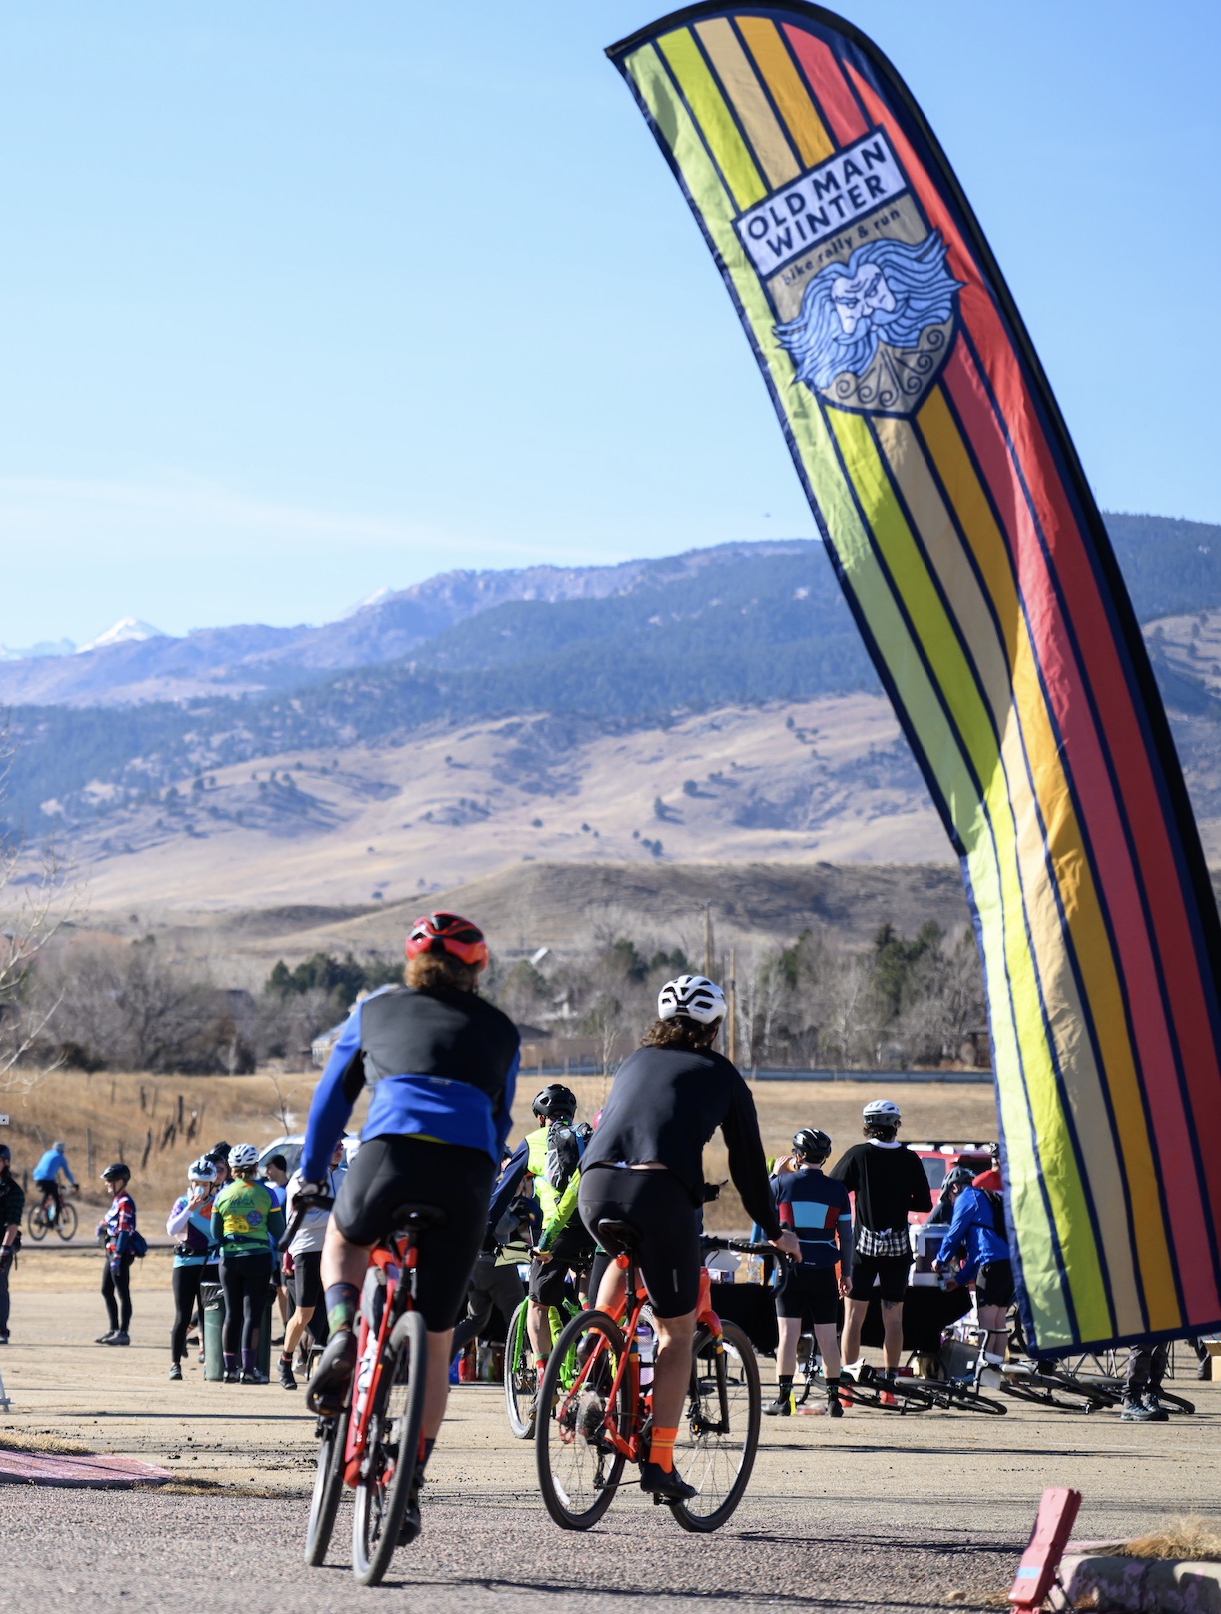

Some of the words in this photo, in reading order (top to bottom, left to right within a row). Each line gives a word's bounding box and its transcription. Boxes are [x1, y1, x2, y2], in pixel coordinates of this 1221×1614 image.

[748, 192, 806, 240] OLD
[812, 140, 887, 202] MAN
[766, 174, 887, 258] WINTER
[782, 260, 814, 286] bike
[818, 236, 853, 262] rally
[857, 225, 869, 239] &
[873, 209, 901, 230] run
